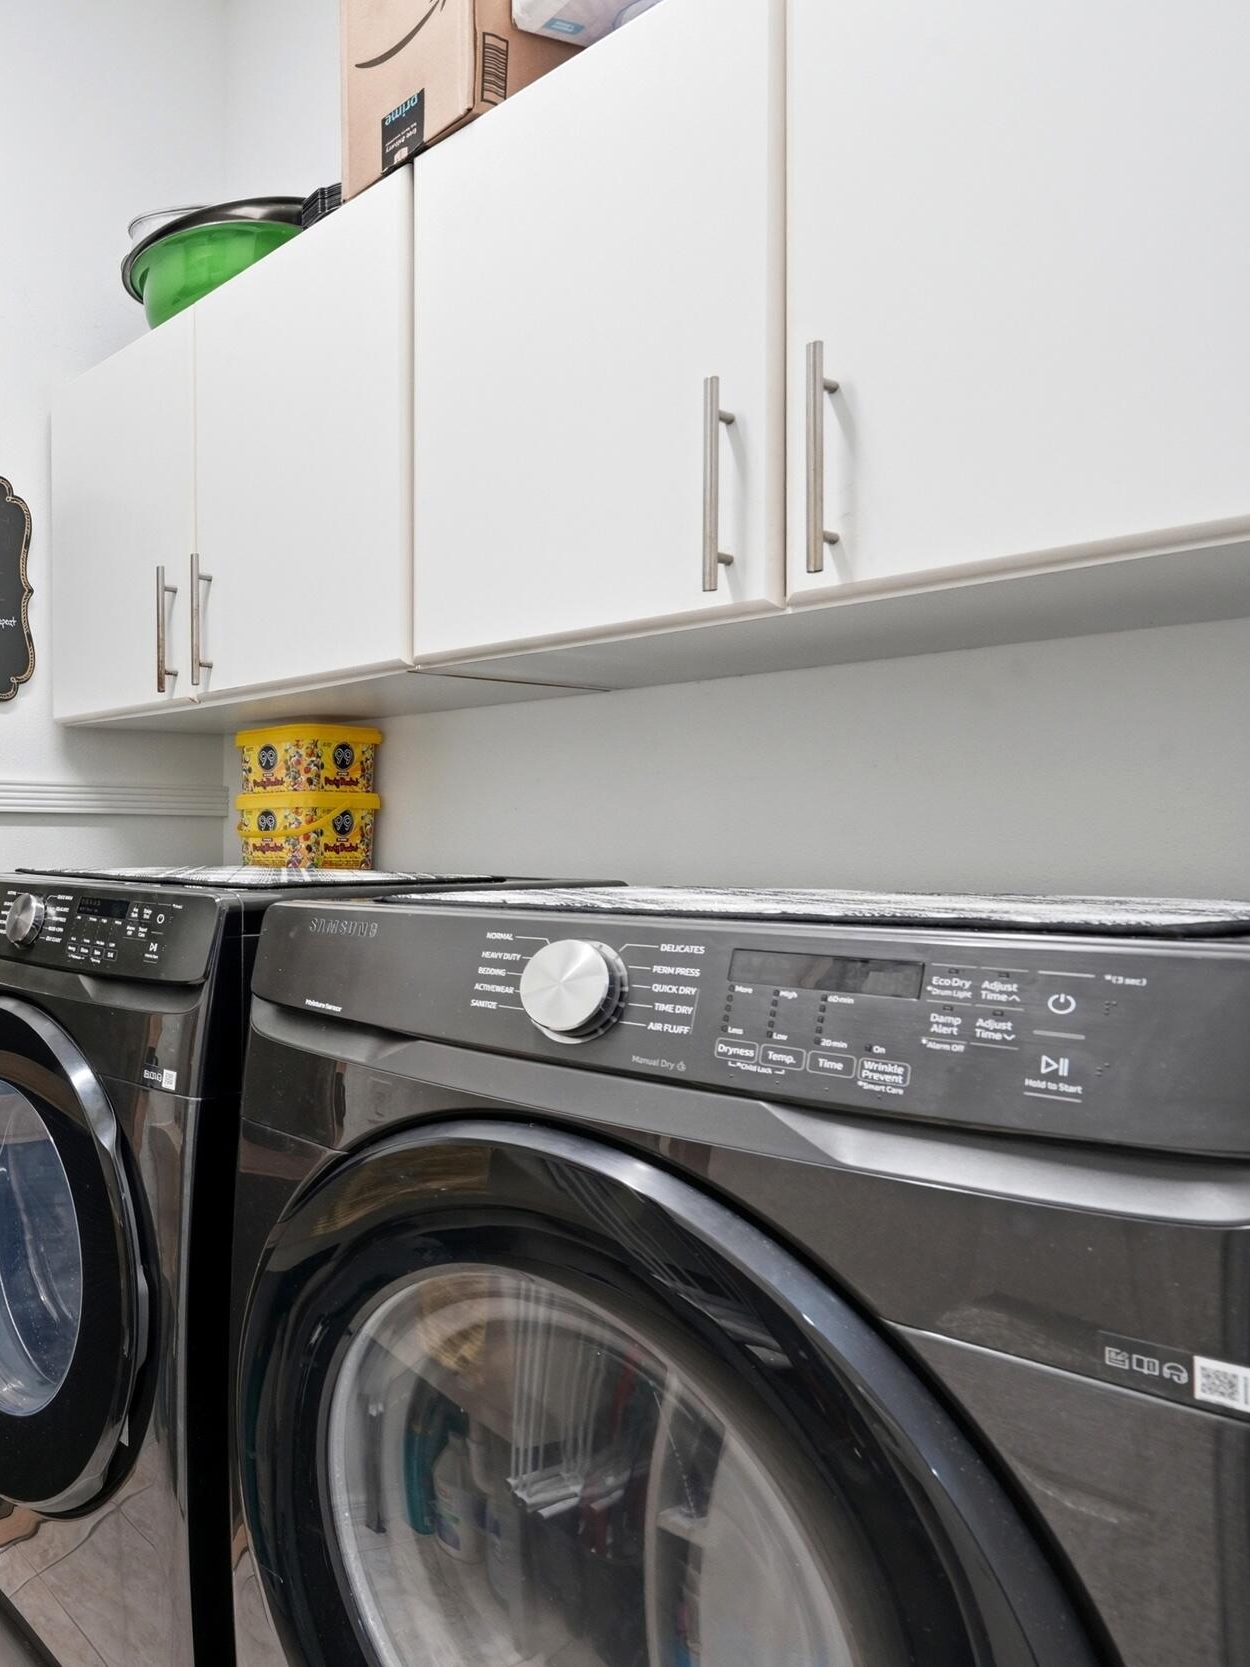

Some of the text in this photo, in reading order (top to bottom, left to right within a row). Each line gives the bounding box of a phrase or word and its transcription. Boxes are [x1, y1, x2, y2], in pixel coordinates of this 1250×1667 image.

[384, 92, 418, 125] prime
[310, 917, 379, 938] SAMSUNG
[486, 932, 514, 940] NORMAL
[660, 943, 705, 954] DELICATES
[481, 951, 521, 960] HEAVY DUTY
[478, 966, 507, 976] BEDDING
[652, 965, 701, 977] PERM PRESS
[651, 983, 698, 995] QUICK DRY
[932, 976, 972, 989] Eco Dry
[981, 980, 1018, 992] Adjust
[981, 990, 1008, 1002] Time
[654, 1002, 694, 1015] TIME DRY
[930, 1013, 962, 1026] Damp
[975, 1018, 1013, 1031] Adjust
[647, 1021, 691, 1035] AIR FLUFF
[930, 1023, 958, 1036] Alert
[975, 1028, 1003, 1040] Time
[717, 1043, 755, 1057] Dryness
[872, 1045, 886, 1054] On
[631, 1055, 675, 1071] Manual Dry
[767, 1050, 797, 1065] Temp.
[818, 1057, 844, 1071] Time
[863, 1060, 905, 1075] Wrinkle
[861, 1069, 904, 1085] Prevent
[885, 1085, 904, 1096] Care
[1025, 1078, 1083, 1094] Hold to Start
